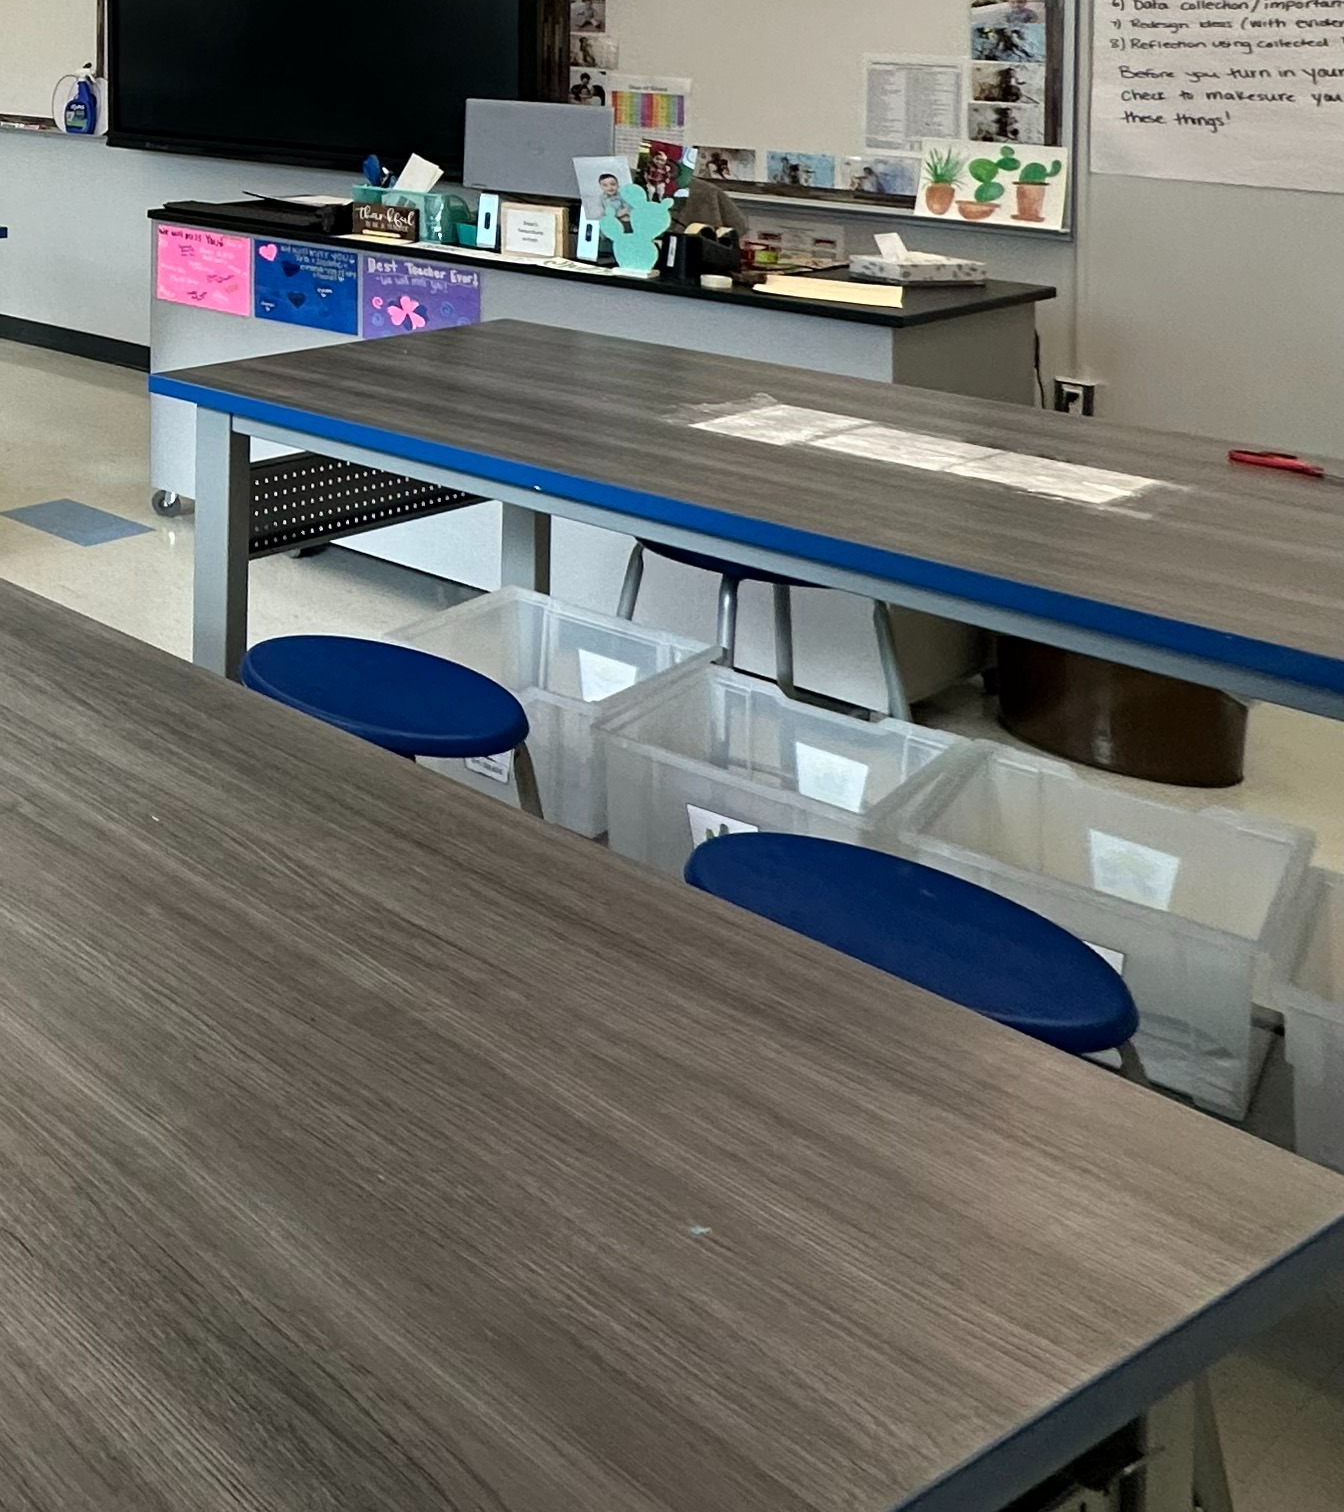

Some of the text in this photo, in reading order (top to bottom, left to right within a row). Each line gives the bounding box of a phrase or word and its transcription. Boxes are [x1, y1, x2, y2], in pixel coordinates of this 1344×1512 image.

[1133, 0, 1170, 11] Data
[1130, 38, 1207, 50] Reflection
[1211, 40, 1254, 54] using
[1256, 37, 1329, 49] collected
[1118, 65, 1176, 79] Before
[1185, 70, 1221, 83] you
[1226, 67, 1272, 79] turn
[1278, 68, 1297, 78] in
[1179, 90, 1195, 100] to
[1118, 110, 1232, 133] these things!
[367, 257, 398, 273] Best
[403, 261, 447, 279] Teacher
